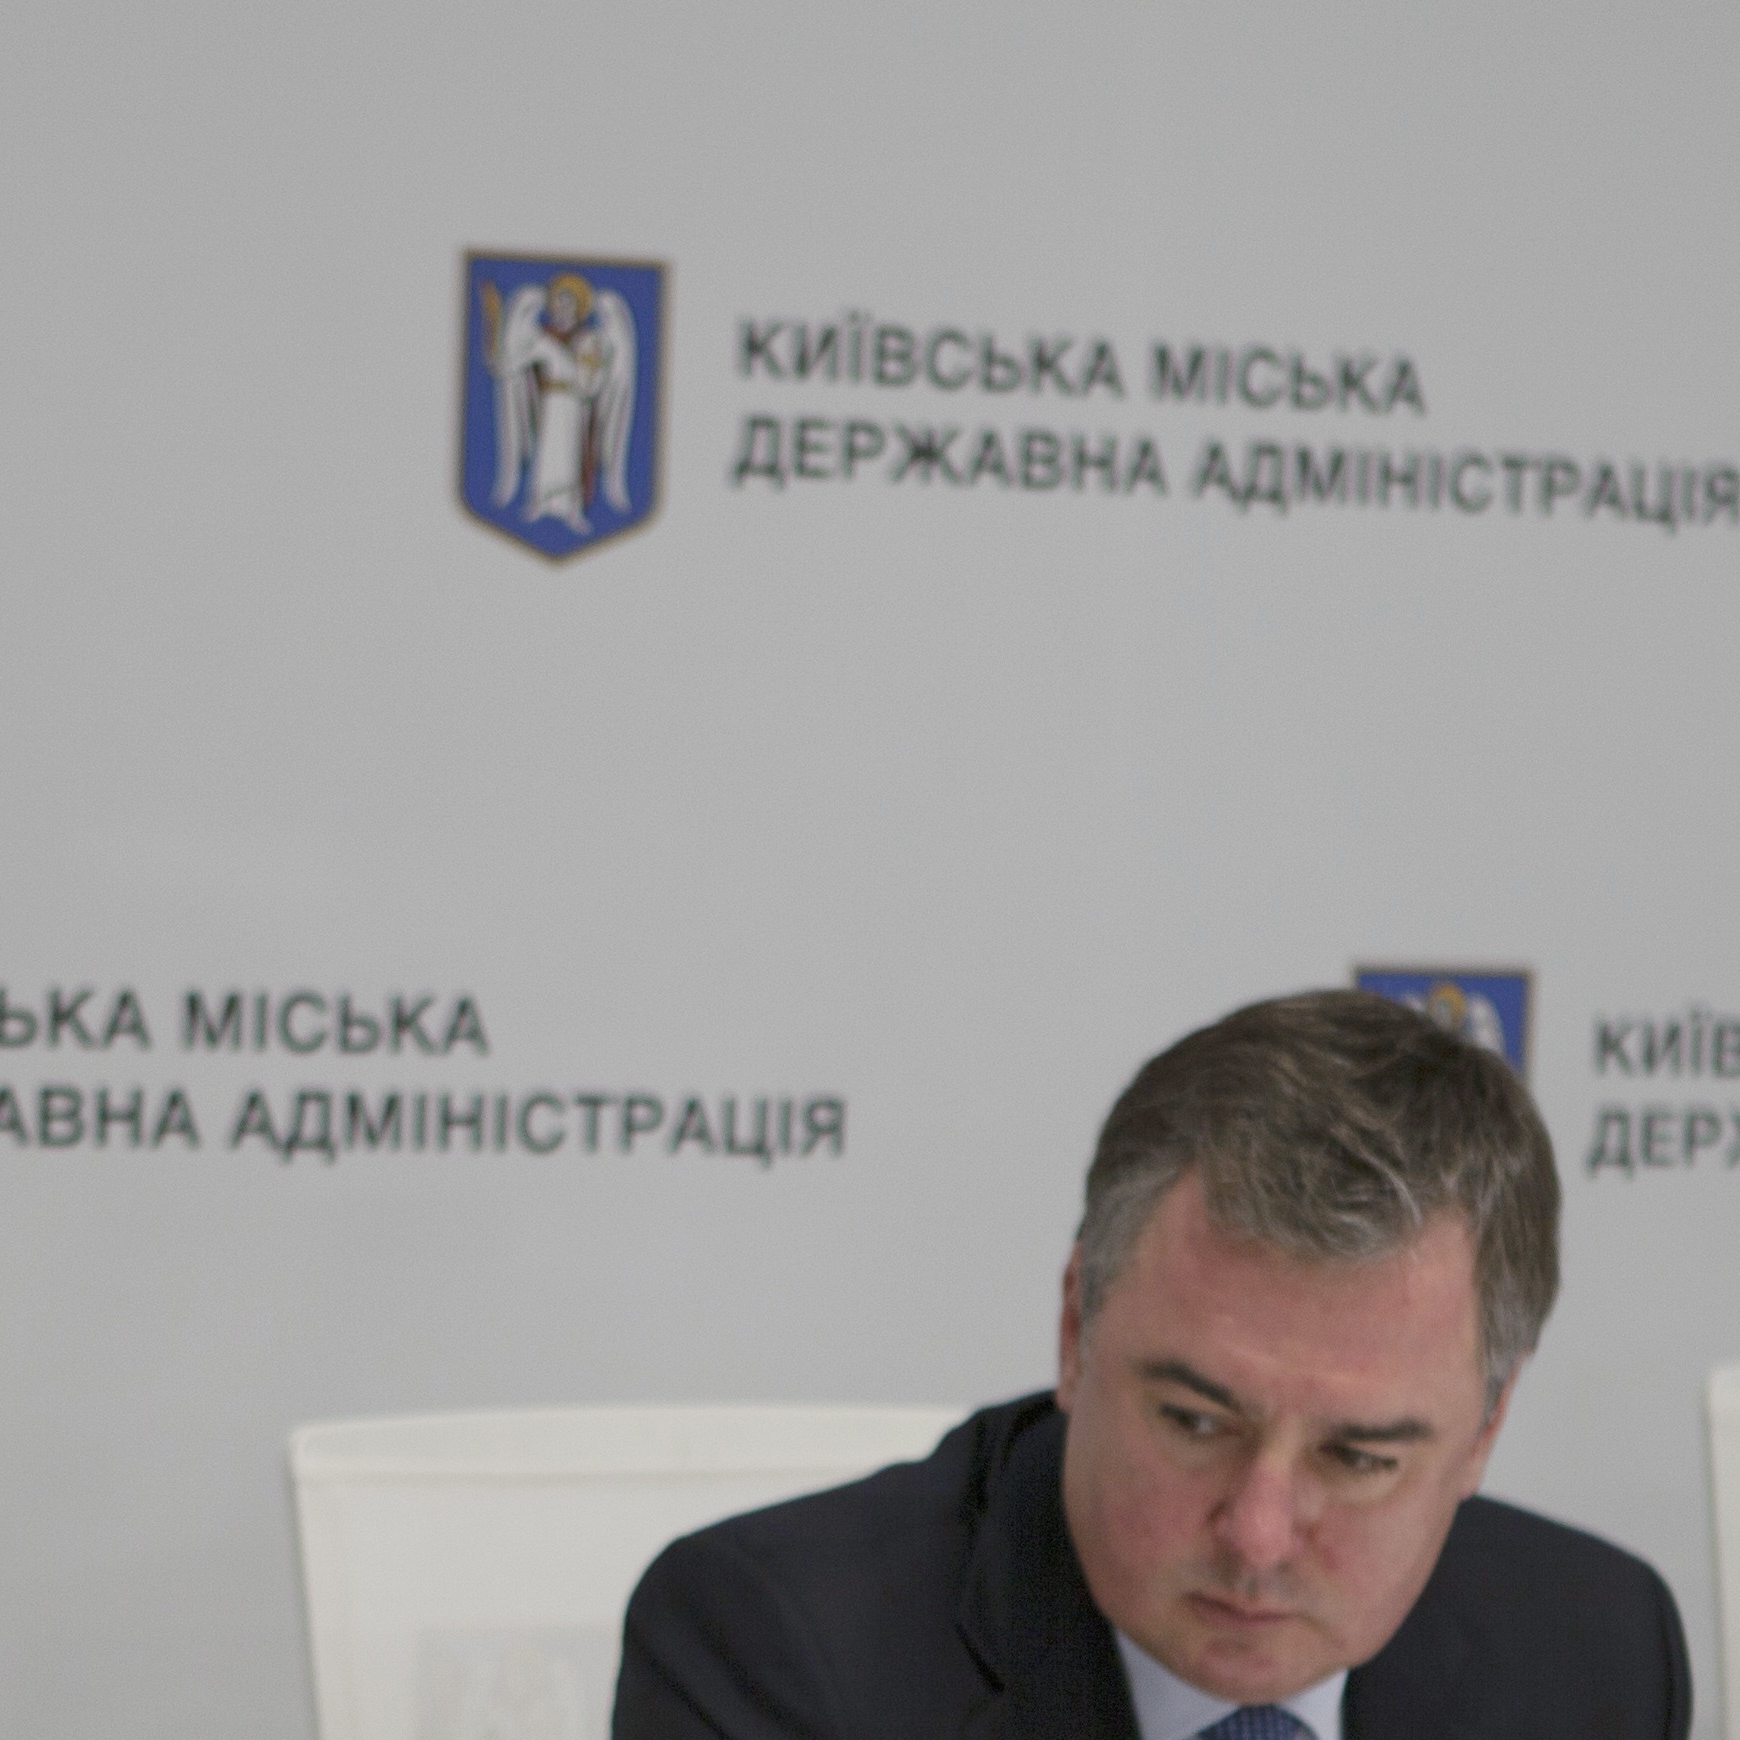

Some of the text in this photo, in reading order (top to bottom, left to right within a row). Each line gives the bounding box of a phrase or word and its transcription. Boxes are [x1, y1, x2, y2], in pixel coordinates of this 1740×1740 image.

[737, 308, 1427, 416] КИЇВСЬКА МІСЬКА
[727, 412, 1169, 497] ДЕРЖАВНА
[180, 988, 490, 1057] МІСЬКА
[228, 1087, 847, 1170] АДМІНІСТРАЦІЯ
